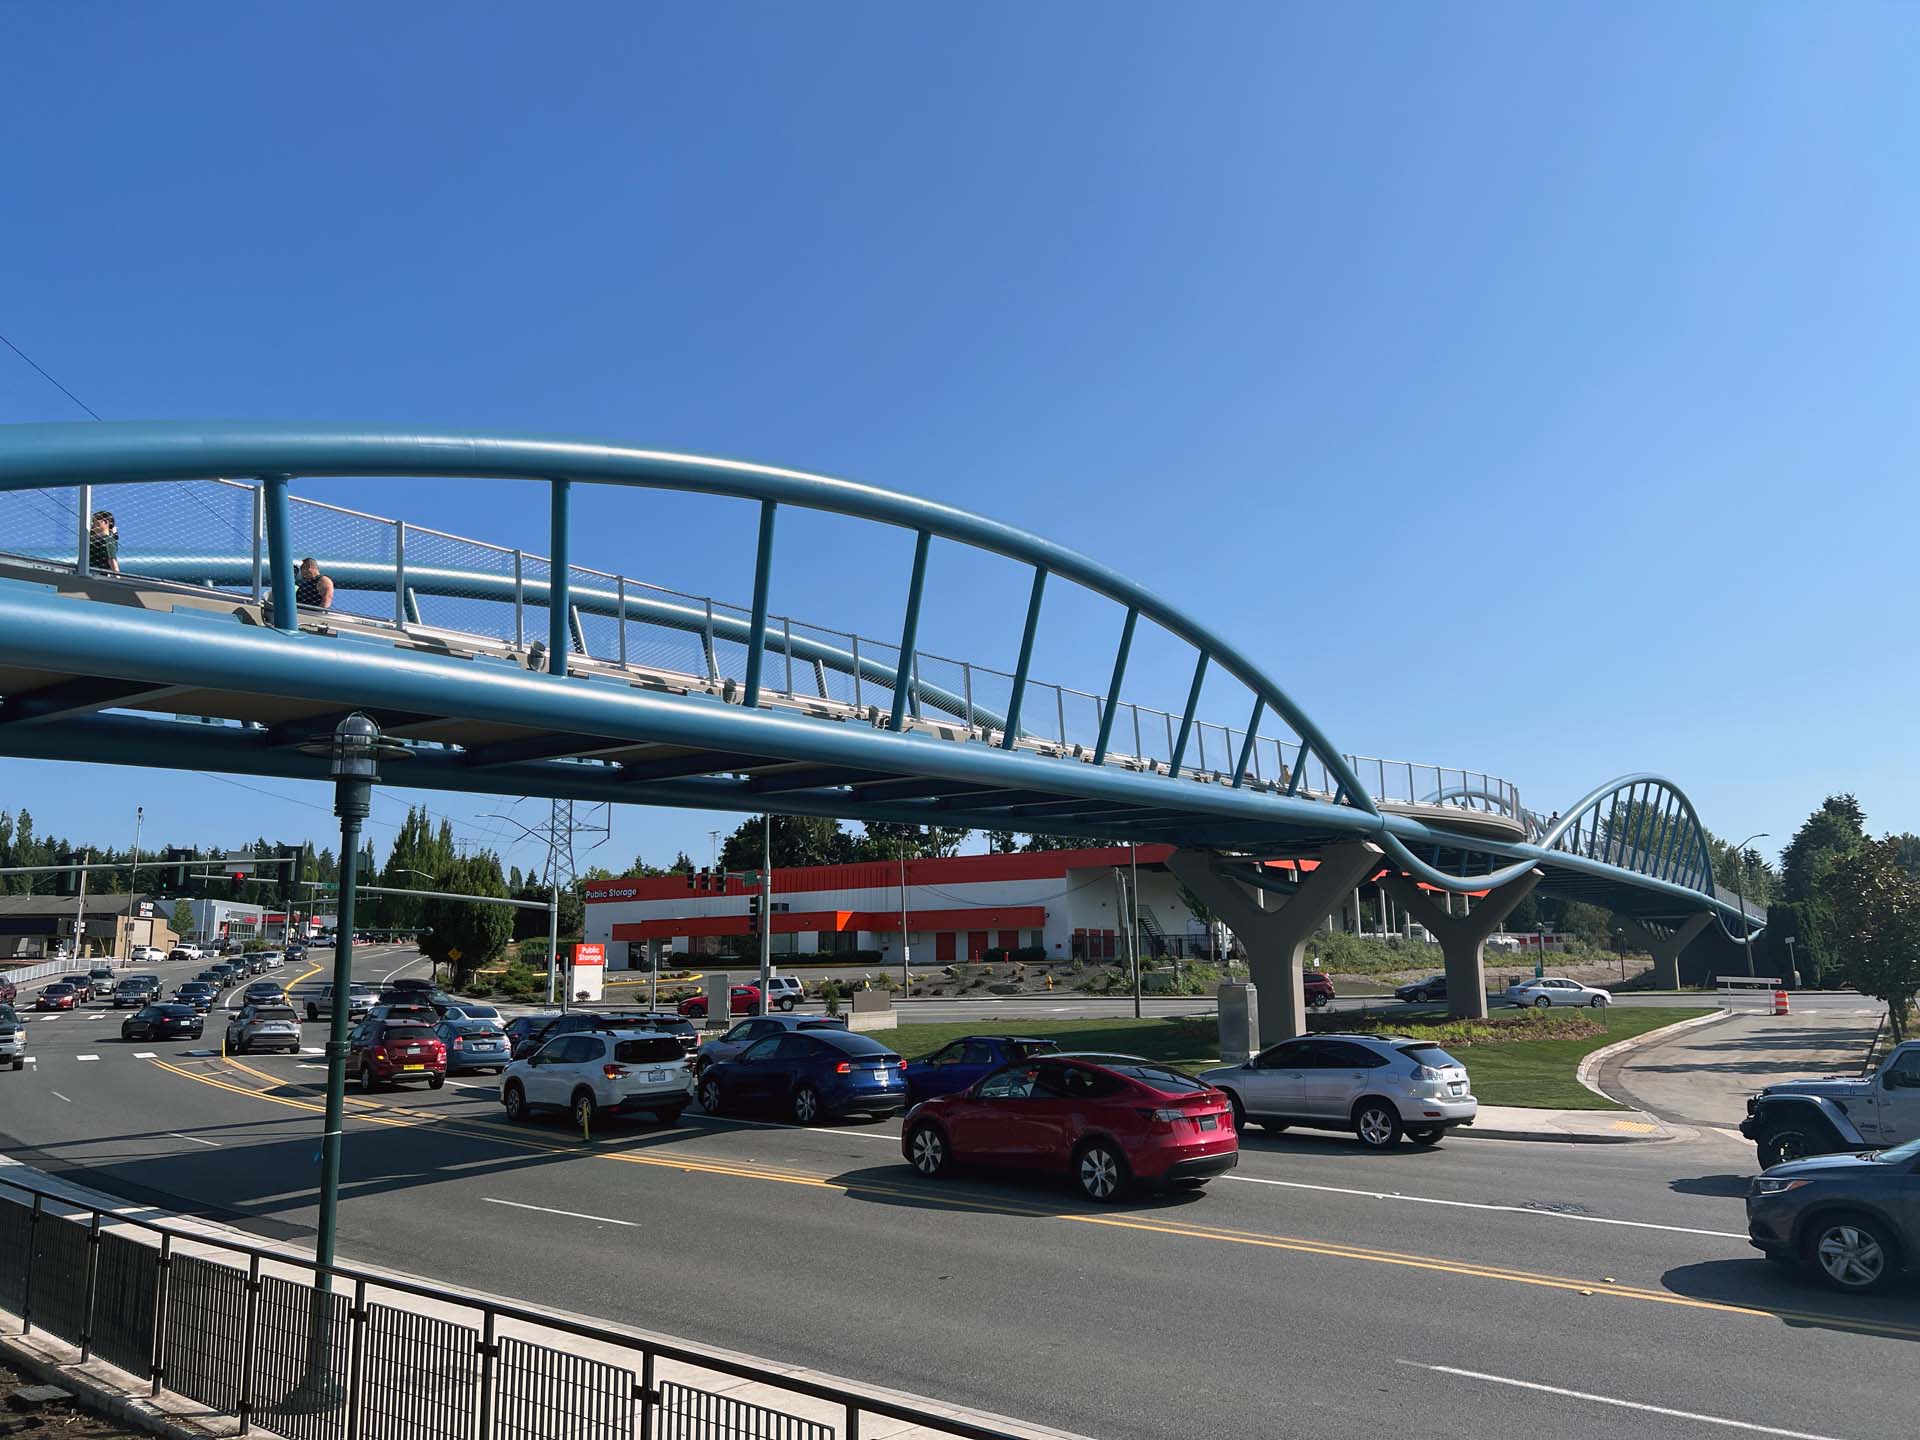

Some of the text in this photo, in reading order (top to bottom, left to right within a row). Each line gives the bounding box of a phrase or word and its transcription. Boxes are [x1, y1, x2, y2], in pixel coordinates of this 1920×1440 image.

[586, 889, 637, 898] Public Storage
[578, 954, 602, 962] Storage
